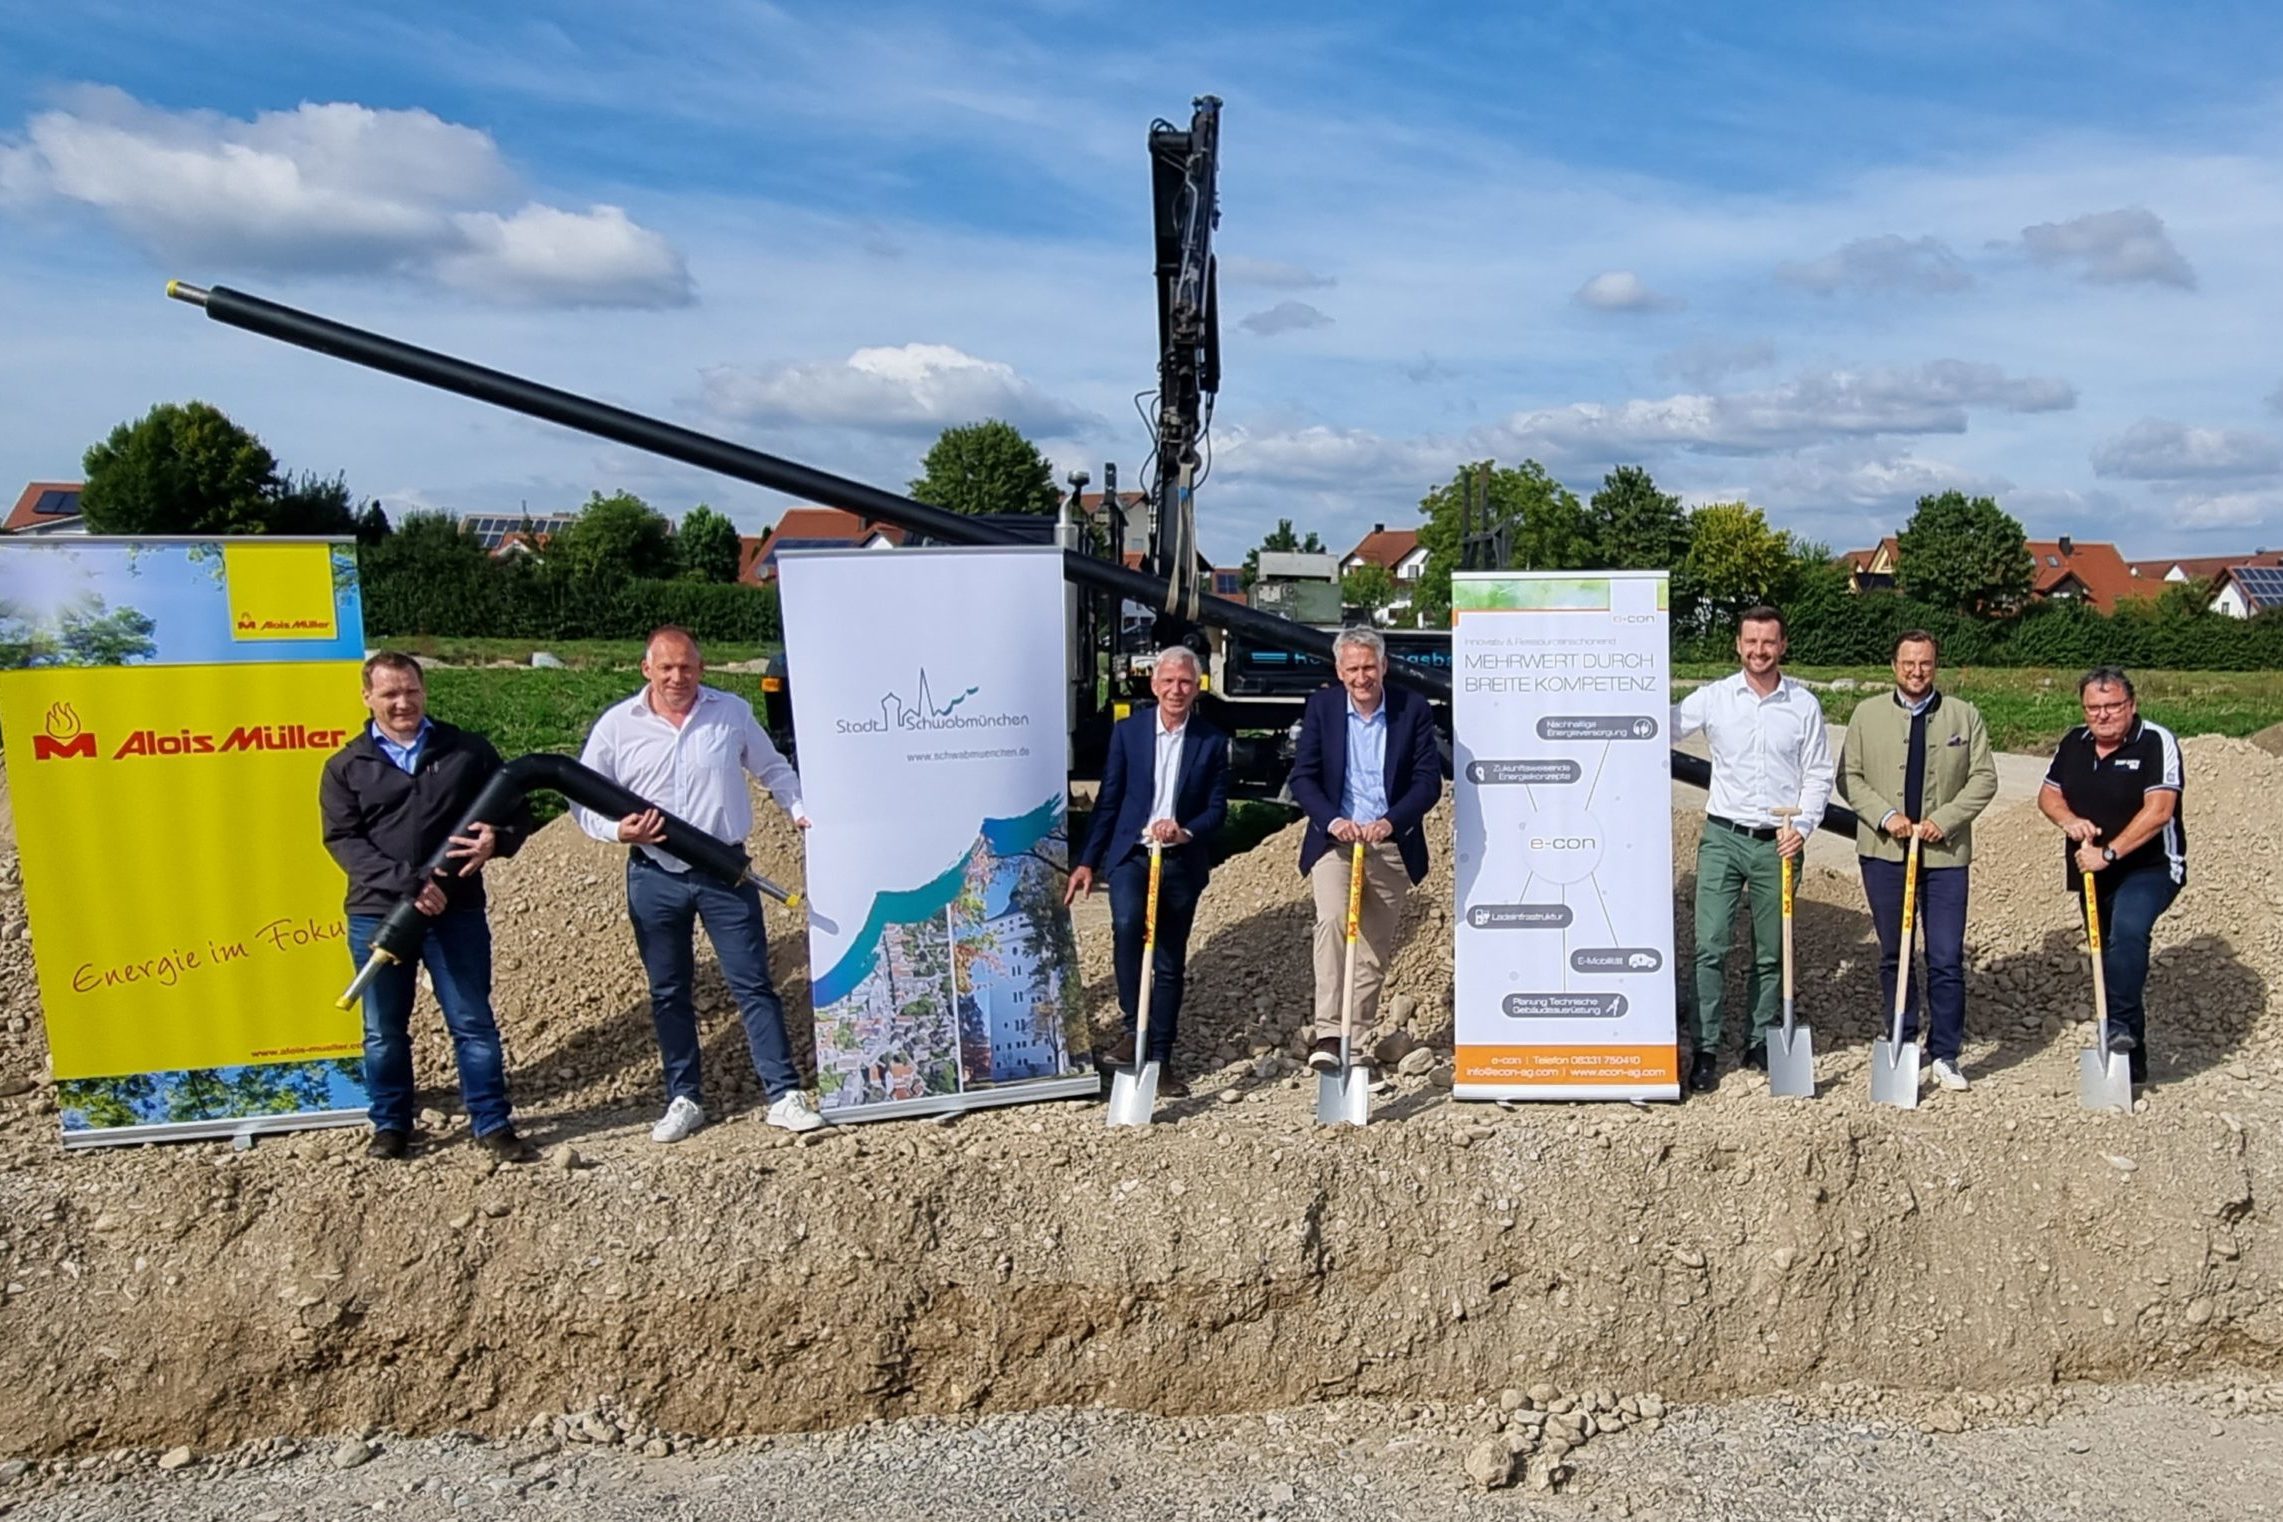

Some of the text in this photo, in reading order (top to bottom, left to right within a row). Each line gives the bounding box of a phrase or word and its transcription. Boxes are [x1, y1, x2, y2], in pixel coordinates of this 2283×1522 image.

[261, 621, 291, 631] Alois
[292, 620, 330, 629] Müller
[1464, 653, 1579, 670] MEHRWERT
[1583, 653, 1654, 669] DURCH
[1464, 676, 1657, 692] BREITE KOMPETENZ
[836, 713, 1030, 734] Stadt Schwabmünchen
[1546, 728, 1628, 738] Energieversorgung
[112, 729, 216, 761] Alois
[218, 724, 347, 753] Müller
[906, 747, 1030, 762] www.schwabmuenchen.de
[1530, 837, 1596, 850] e-con
[71, 918, 347, 993] Energie im Foku
[1512, 997, 1599, 1007] Planung Technische
[251, 1042, 364, 1057] www.alois-mueller.co
[1533, 1055, 1569, 1065] Telefon
